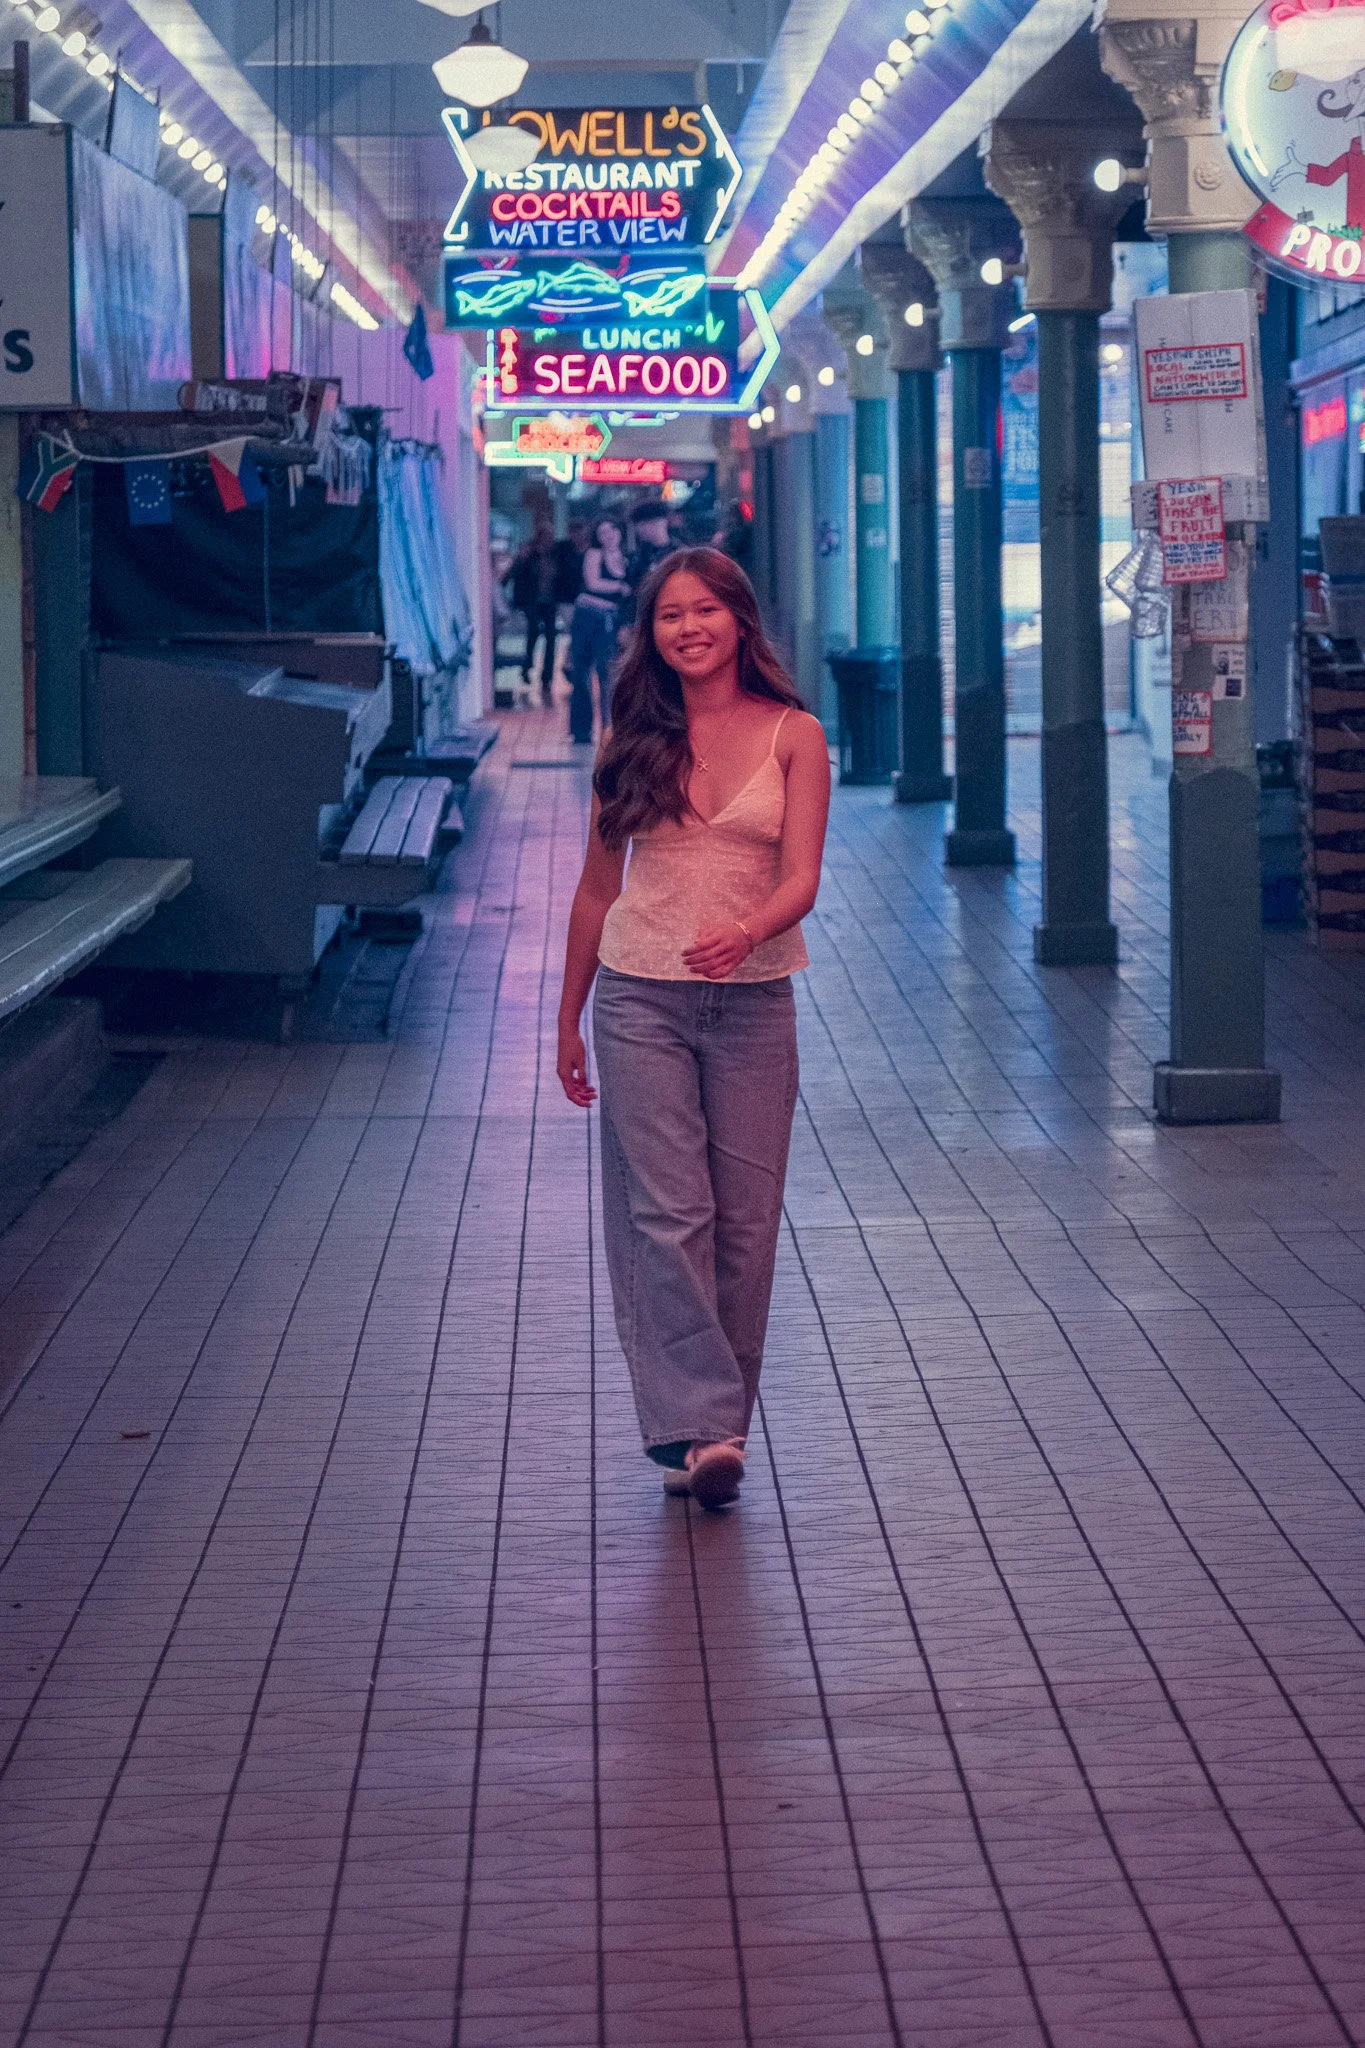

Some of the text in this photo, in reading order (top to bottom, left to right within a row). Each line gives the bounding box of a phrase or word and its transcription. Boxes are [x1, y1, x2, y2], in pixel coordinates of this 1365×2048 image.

[492, 191, 680, 221] COCKTAILS
[489, 217, 687, 246] WATER VIEW
[582, 328, 681, 350] LUNCH
[534, 354, 728, 396] SEAFOOD
[1171, 517, 1215, 533] FRUIT
